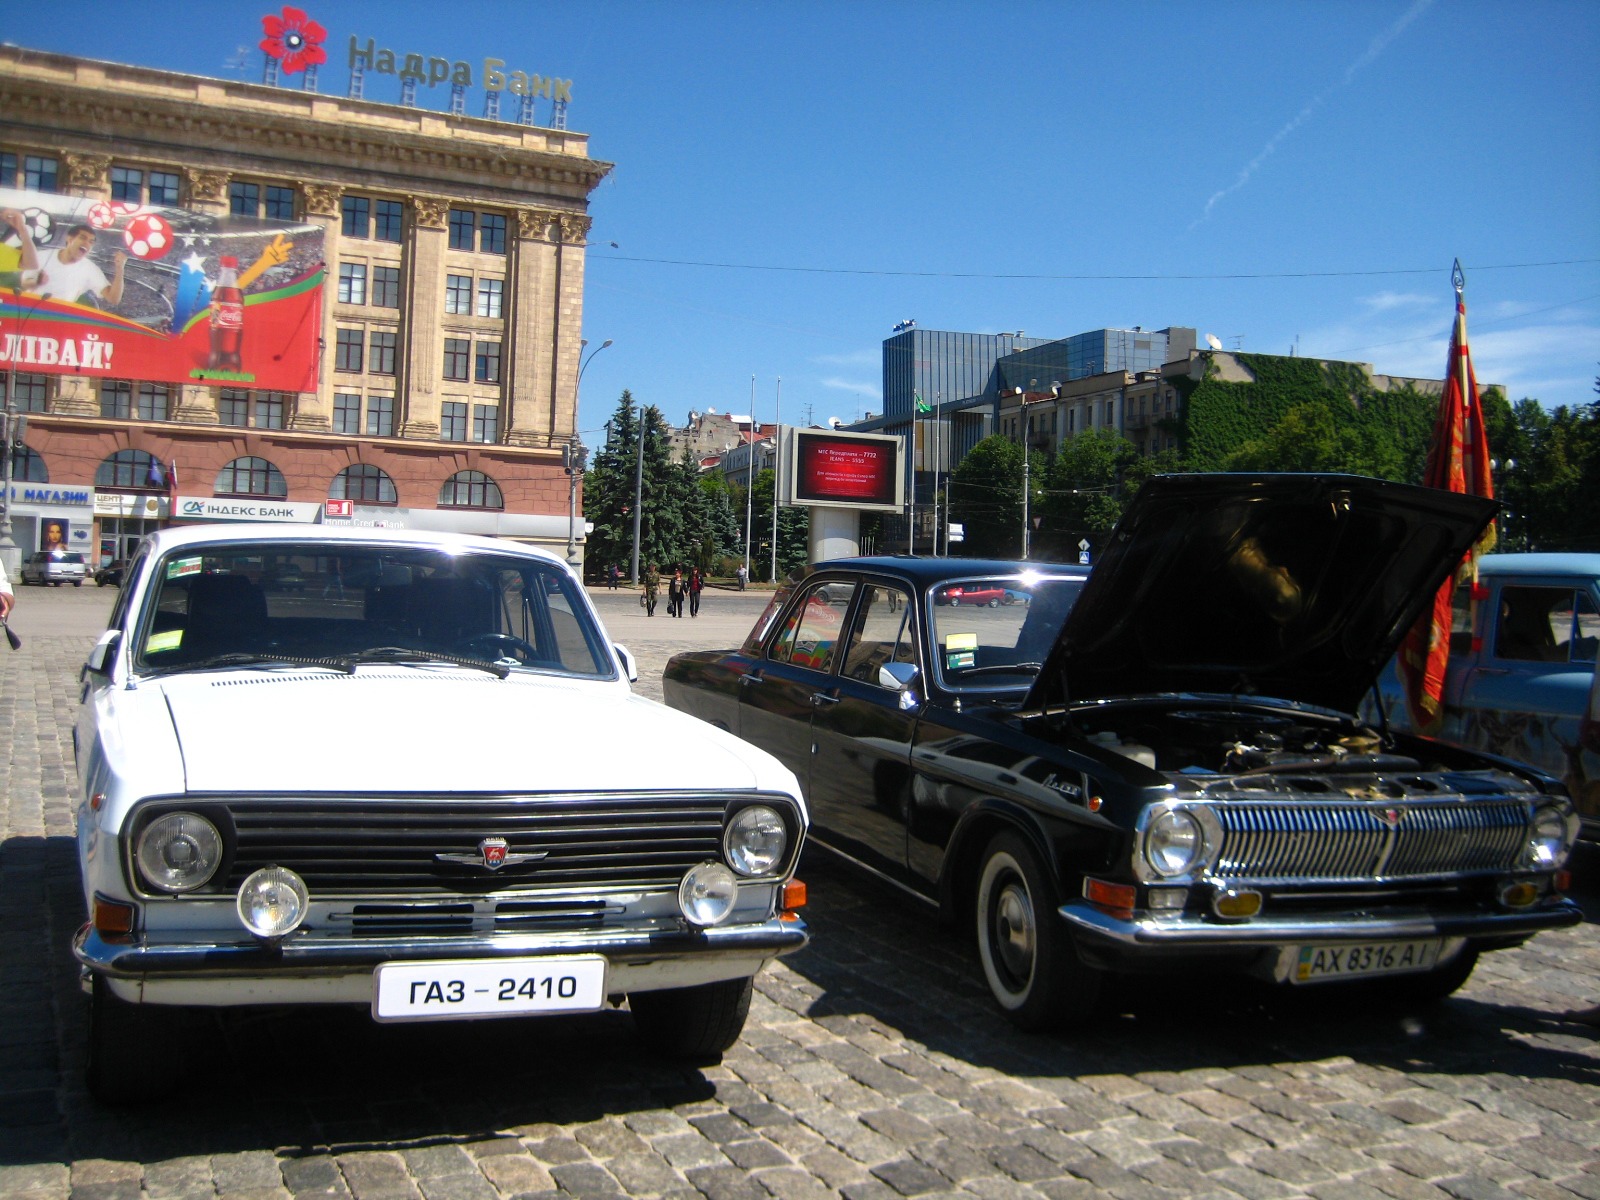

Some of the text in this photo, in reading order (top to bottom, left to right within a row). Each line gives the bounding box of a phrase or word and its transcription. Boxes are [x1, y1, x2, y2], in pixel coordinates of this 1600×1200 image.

[349, 34, 573, 102] Надра Банк
[25, 489, 88, 502] МАГАЗИН
[207, 505, 294, 517] ІНДЕКС БАНК
[325, 518, 350, 526] Home
[1347, 945, 1396, 971] 8316
[409, 980, 466, 1004] ГАЗ
[498, 976, 577, 1001] 2410
